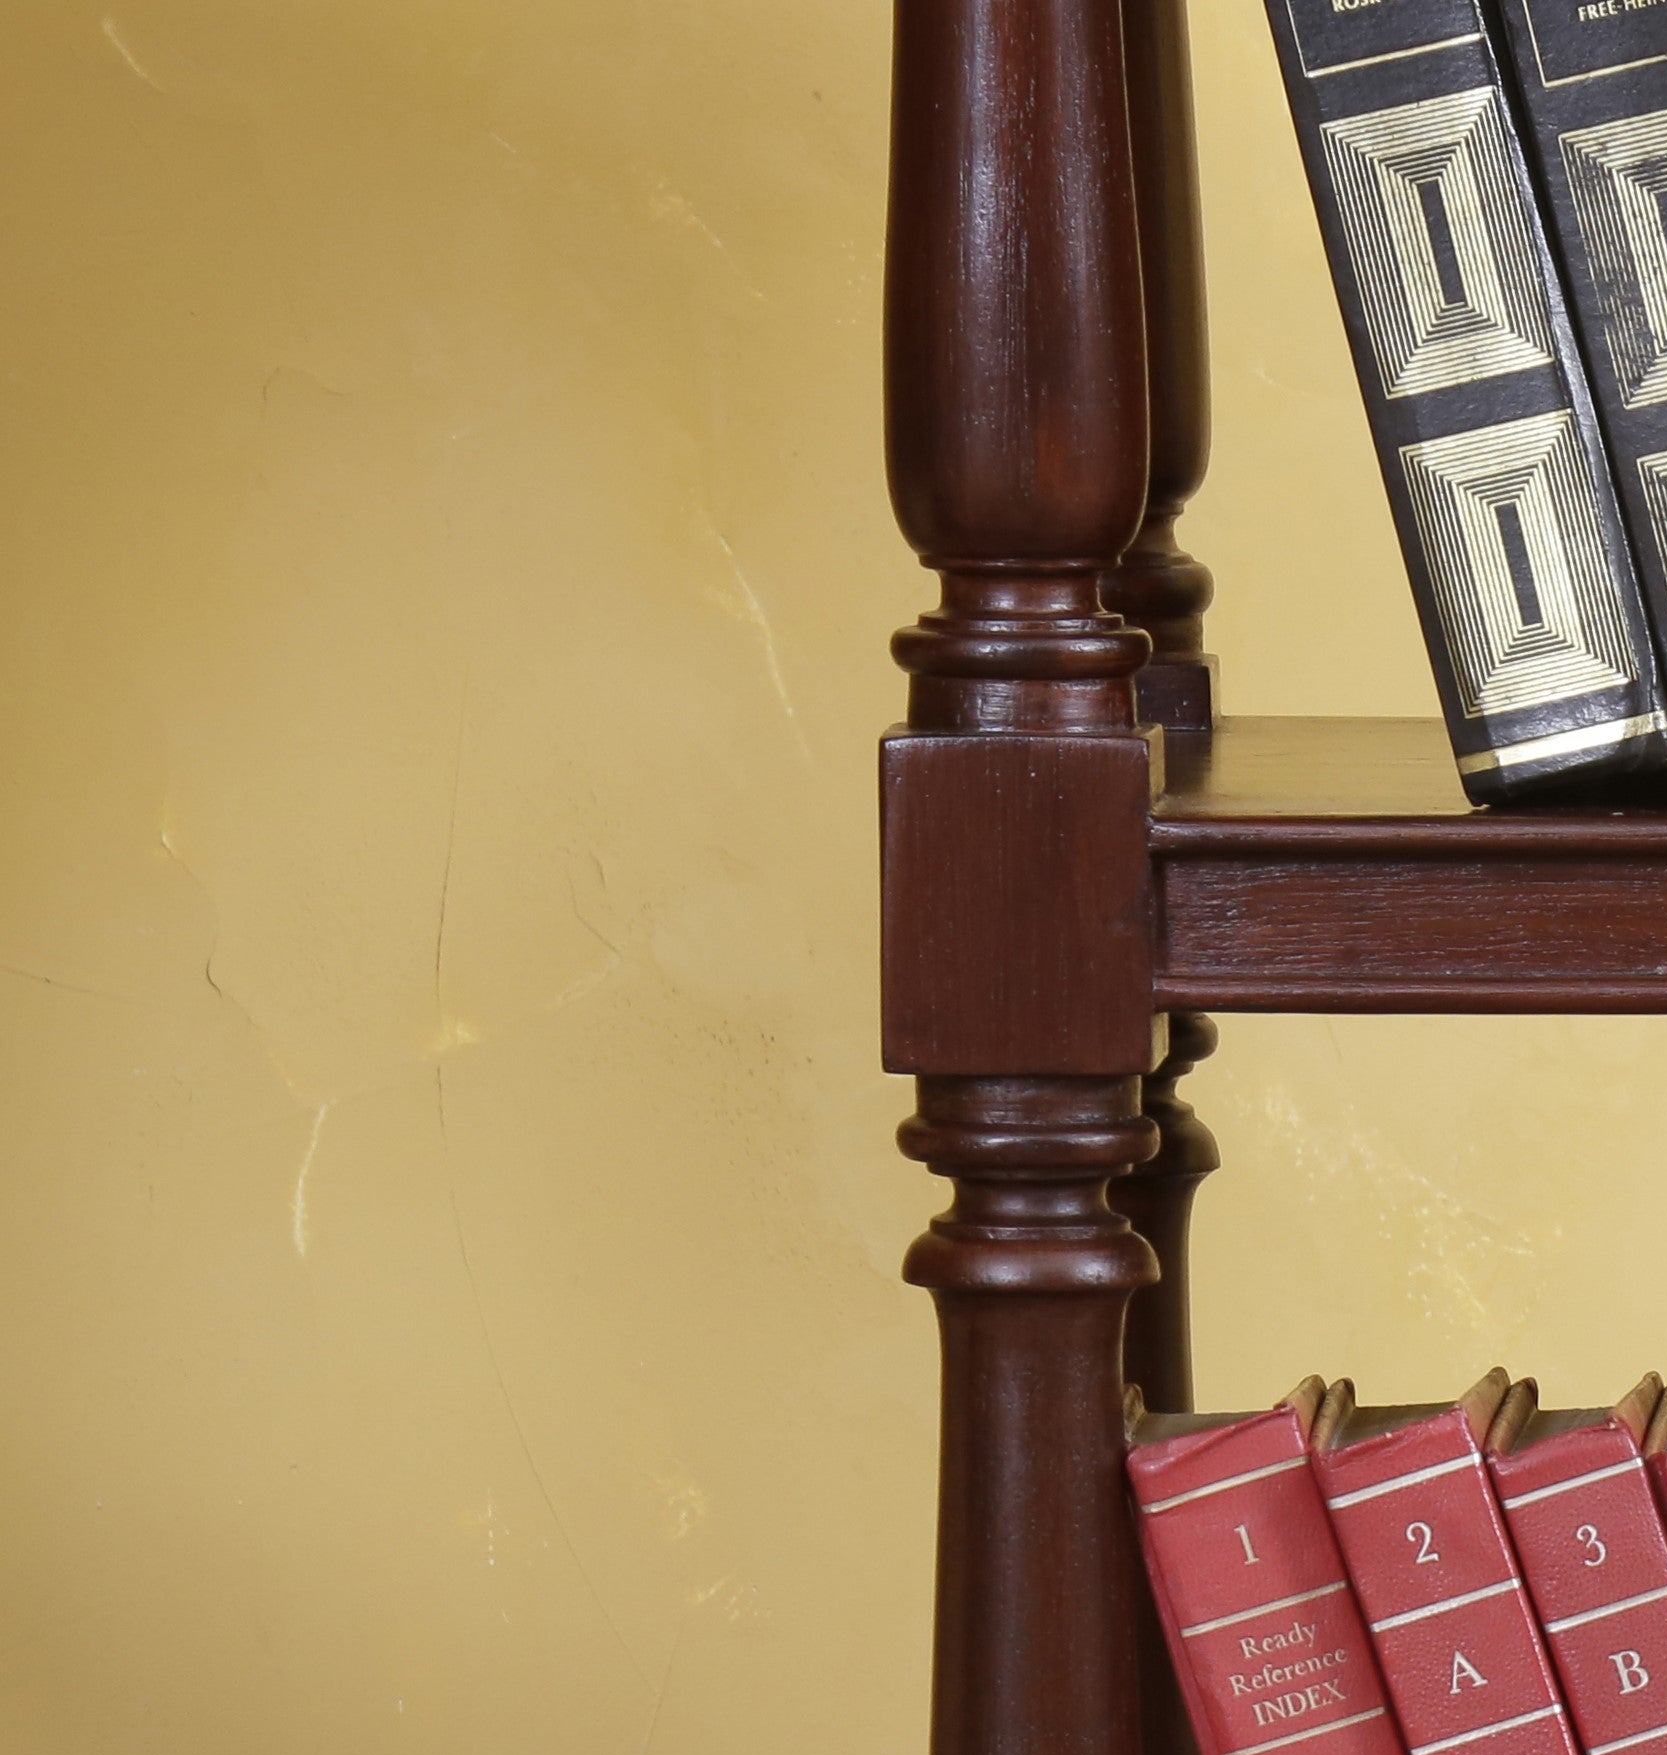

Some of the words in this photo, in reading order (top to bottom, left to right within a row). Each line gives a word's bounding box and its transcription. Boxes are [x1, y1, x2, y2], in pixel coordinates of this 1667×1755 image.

[1234, 1524, 1259, 1565] 1
[1406, 1522, 1439, 1564] 2
[1576, 1524, 1606, 1567] 3
[1239, 1621, 1317, 1660] Ready
[1229, 1648, 1347, 1697] Reference
[1450, 1651, 1488, 1695] A
[1609, 1651, 1649, 1695] B
[1253, 1682, 1345, 1726] INDEX
